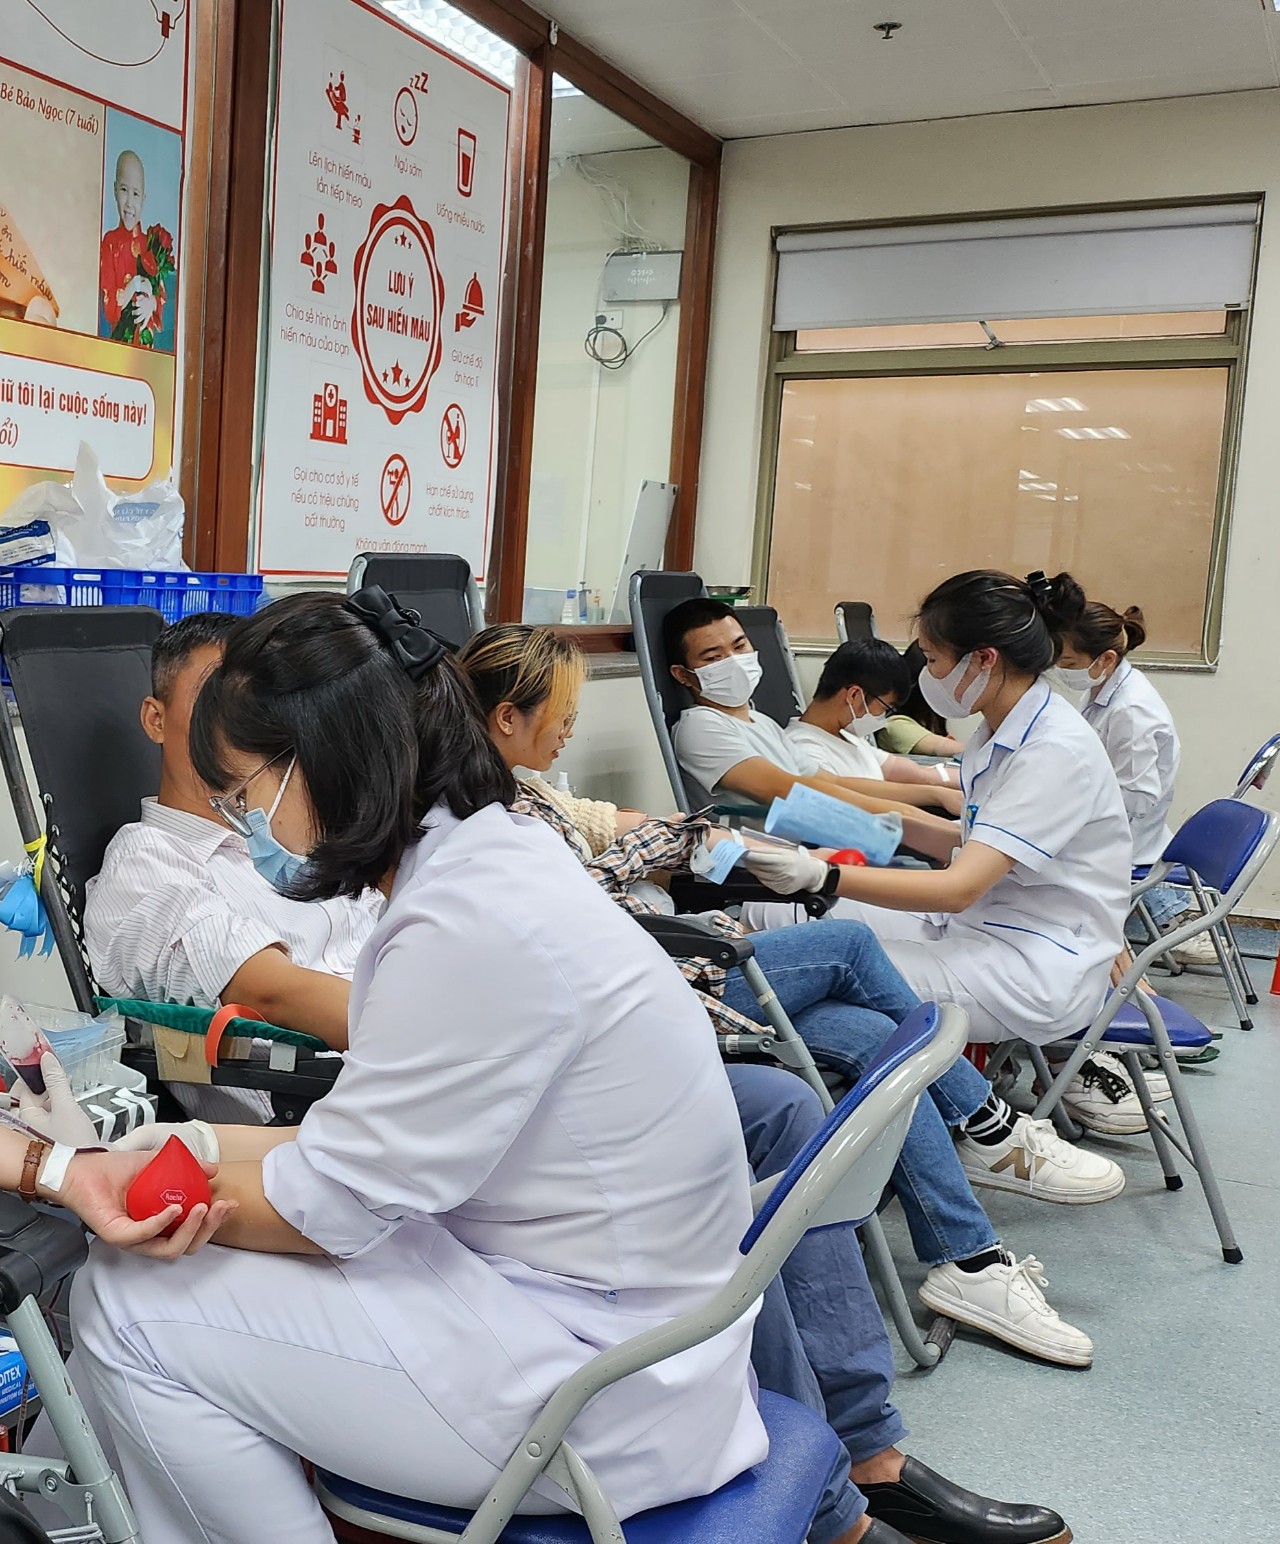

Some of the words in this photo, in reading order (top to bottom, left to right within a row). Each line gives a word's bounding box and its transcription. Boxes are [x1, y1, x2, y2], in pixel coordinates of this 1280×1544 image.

[0, 82, 14, 102] Bé
[16, 88, 36, 110] Bảo
[38, 96, 63, 122] Ngọc
[65, 108, 76, 125] (7
[77, 114, 99, 136] tuổi)
[309, 150, 323, 169] Lên
[338, 163, 354, 182] hiến
[355, 173, 372, 189] máu
[394, 154, 408, 174] Ngủ
[409, 163, 423, 179] sớm
[316, 176, 328, 195] lần
[330, 184, 345, 203] tiếp
[346, 190, 363, 209] theo
[436, 202, 453, 224] Uống
[454, 211, 470, 228] nhiều
[471, 219, 485, 234] nước
[388, 270, 406, 296] LƯU
[408, 272, 415, 298] Ý
[286, 303, 304, 320] Chia
[305, 308, 315, 323] sẻ
[316, 311, 331, 328] hình
[333, 315, 347, 332] ảnh
[367, 304, 385, 329] SAU
[387, 306, 408, 336] HIẾN
[411, 315, 431, 342] MÁU
[280, 326, 297, 343] hiến
[299, 333, 316, 347] máu
[318, 336, 333, 351] của
[334, 341, 350, 357] bạn
[17, 381, 35, 407] tôi
[38, 385, 55, 415] lại
[59, 391, 89, 420] cuộc
[92, 392, 120, 423] sống
[123, 400, 148, 427] này!
[294, 466, 307, 484] Gọi
[309, 470, 323, 483] cho
[325, 473, 335, 484] cơ
[336, 471, 345, 485] sở
[345, 476, 350, 488] y
[352, 473, 359, 487] tế
[291, 488, 306, 503] nếu
[308, 491, 318, 505] có
[319, 493, 335, 508] triệu
[336, 495, 359, 512] chứng
[304, 512, 318, 527] bất
[319, 514, 345, 532] thường
[355, 537, 377, 552] Không
